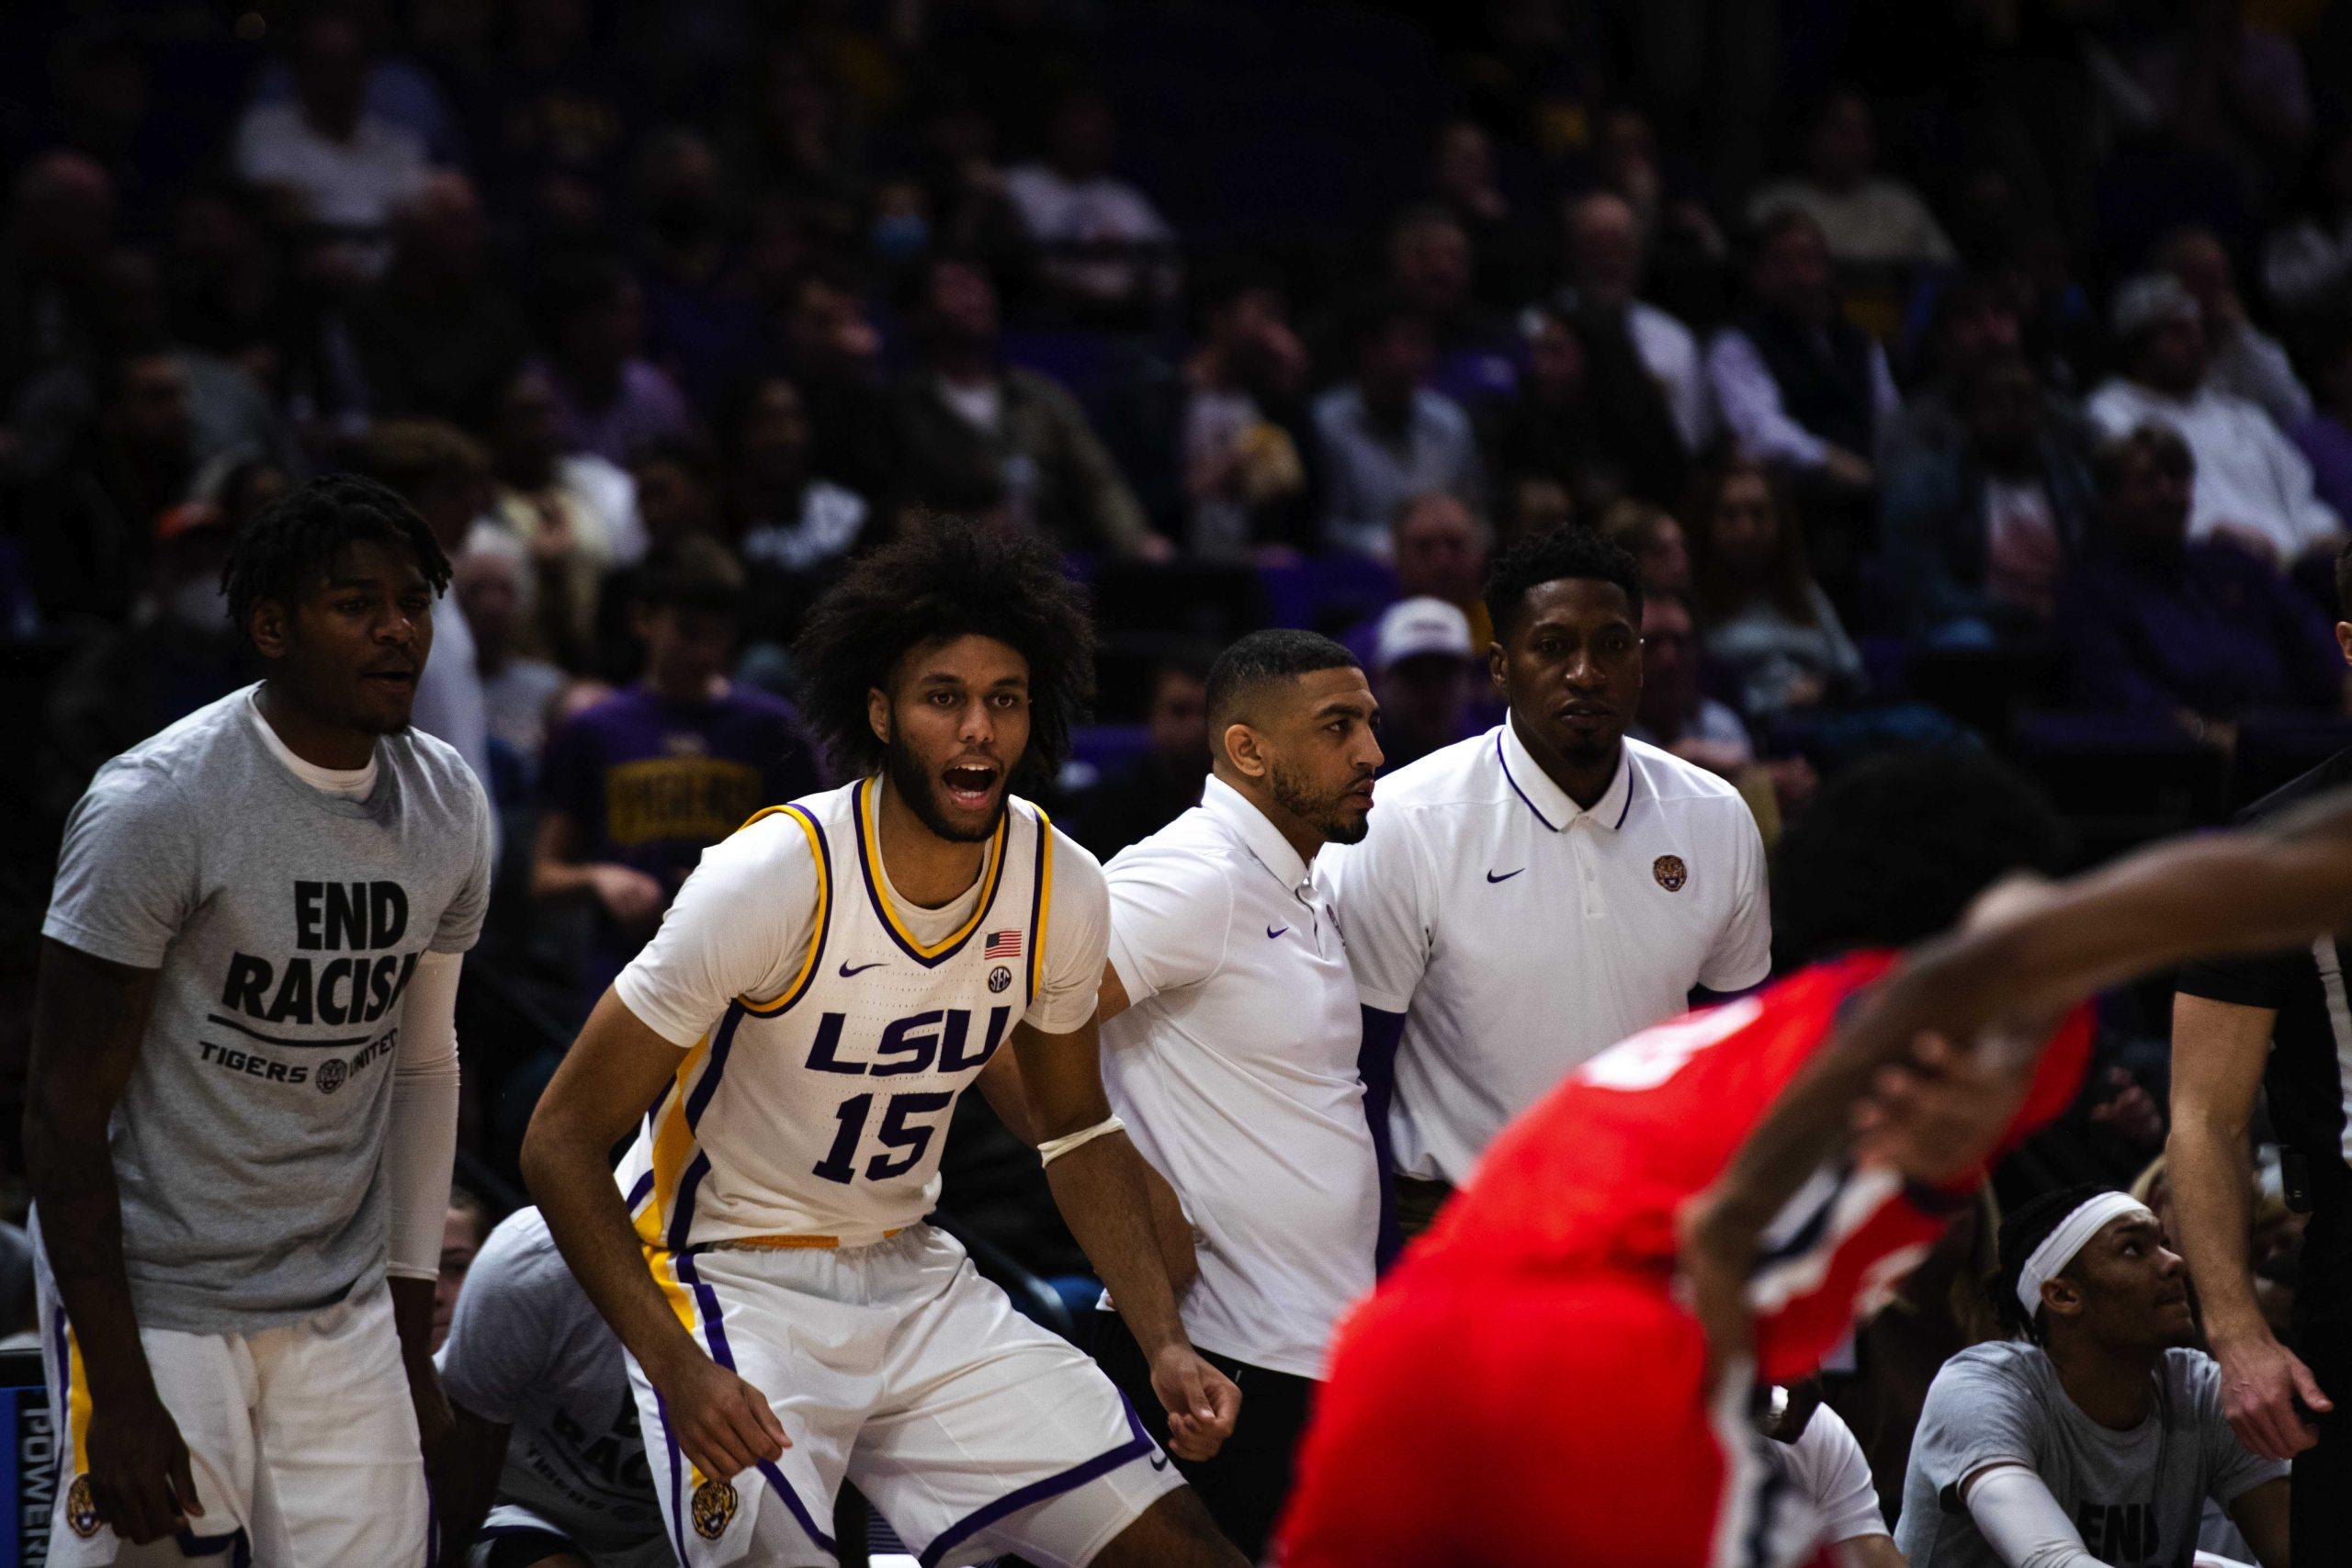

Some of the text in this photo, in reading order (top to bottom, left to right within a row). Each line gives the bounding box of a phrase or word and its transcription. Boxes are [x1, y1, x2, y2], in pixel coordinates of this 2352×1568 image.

[295, 881, 408, 950] END
[990, 967, 1010, 991] SEC
[199, 1041, 308, 1083] TIGERS
[805, 1006, 1011, 1077] LSU
[812, 1089, 955, 1184] 15
